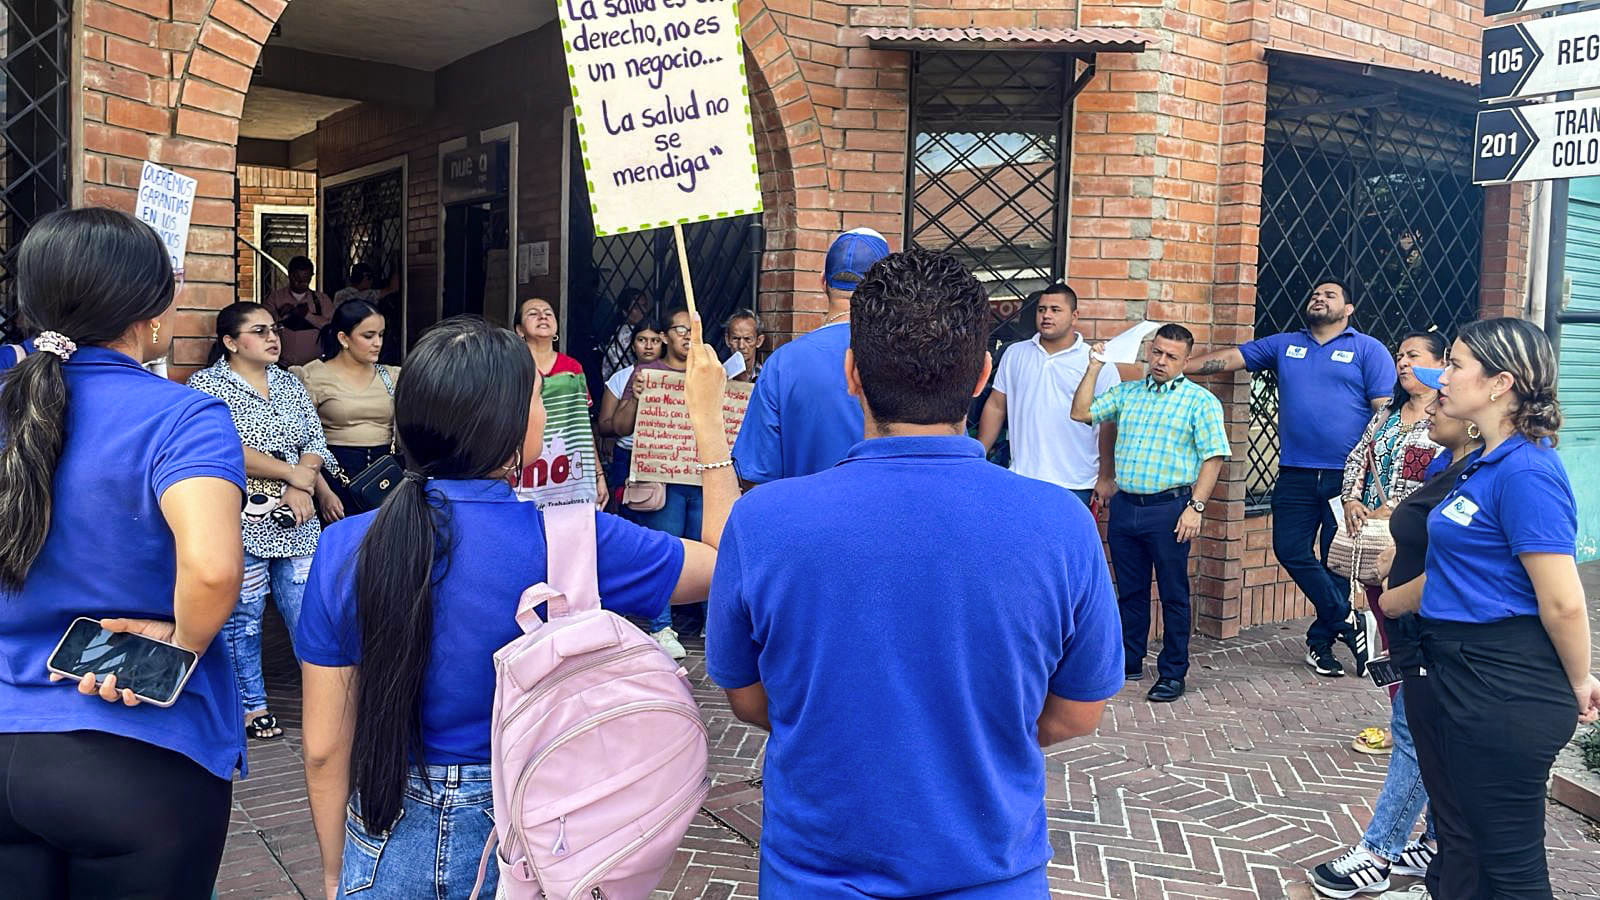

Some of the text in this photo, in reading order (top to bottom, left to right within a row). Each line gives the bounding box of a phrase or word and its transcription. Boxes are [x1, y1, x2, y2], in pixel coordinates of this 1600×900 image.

[567, 0, 597, 20] La
[664, 21, 690, 41] no
[694, 16, 720, 35] es
[1487, 34, 1600, 75] 105 REG
[588, 47, 723, 89] un negocio...
[642, 89, 700, 128] salud
[706, 97, 729, 116] no
[1555, 107, 1600, 136] TRAN
[654, 132, 681, 151] se
[1481, 132, 1518, 158] 201
[142, 206, 158, 224] EN
